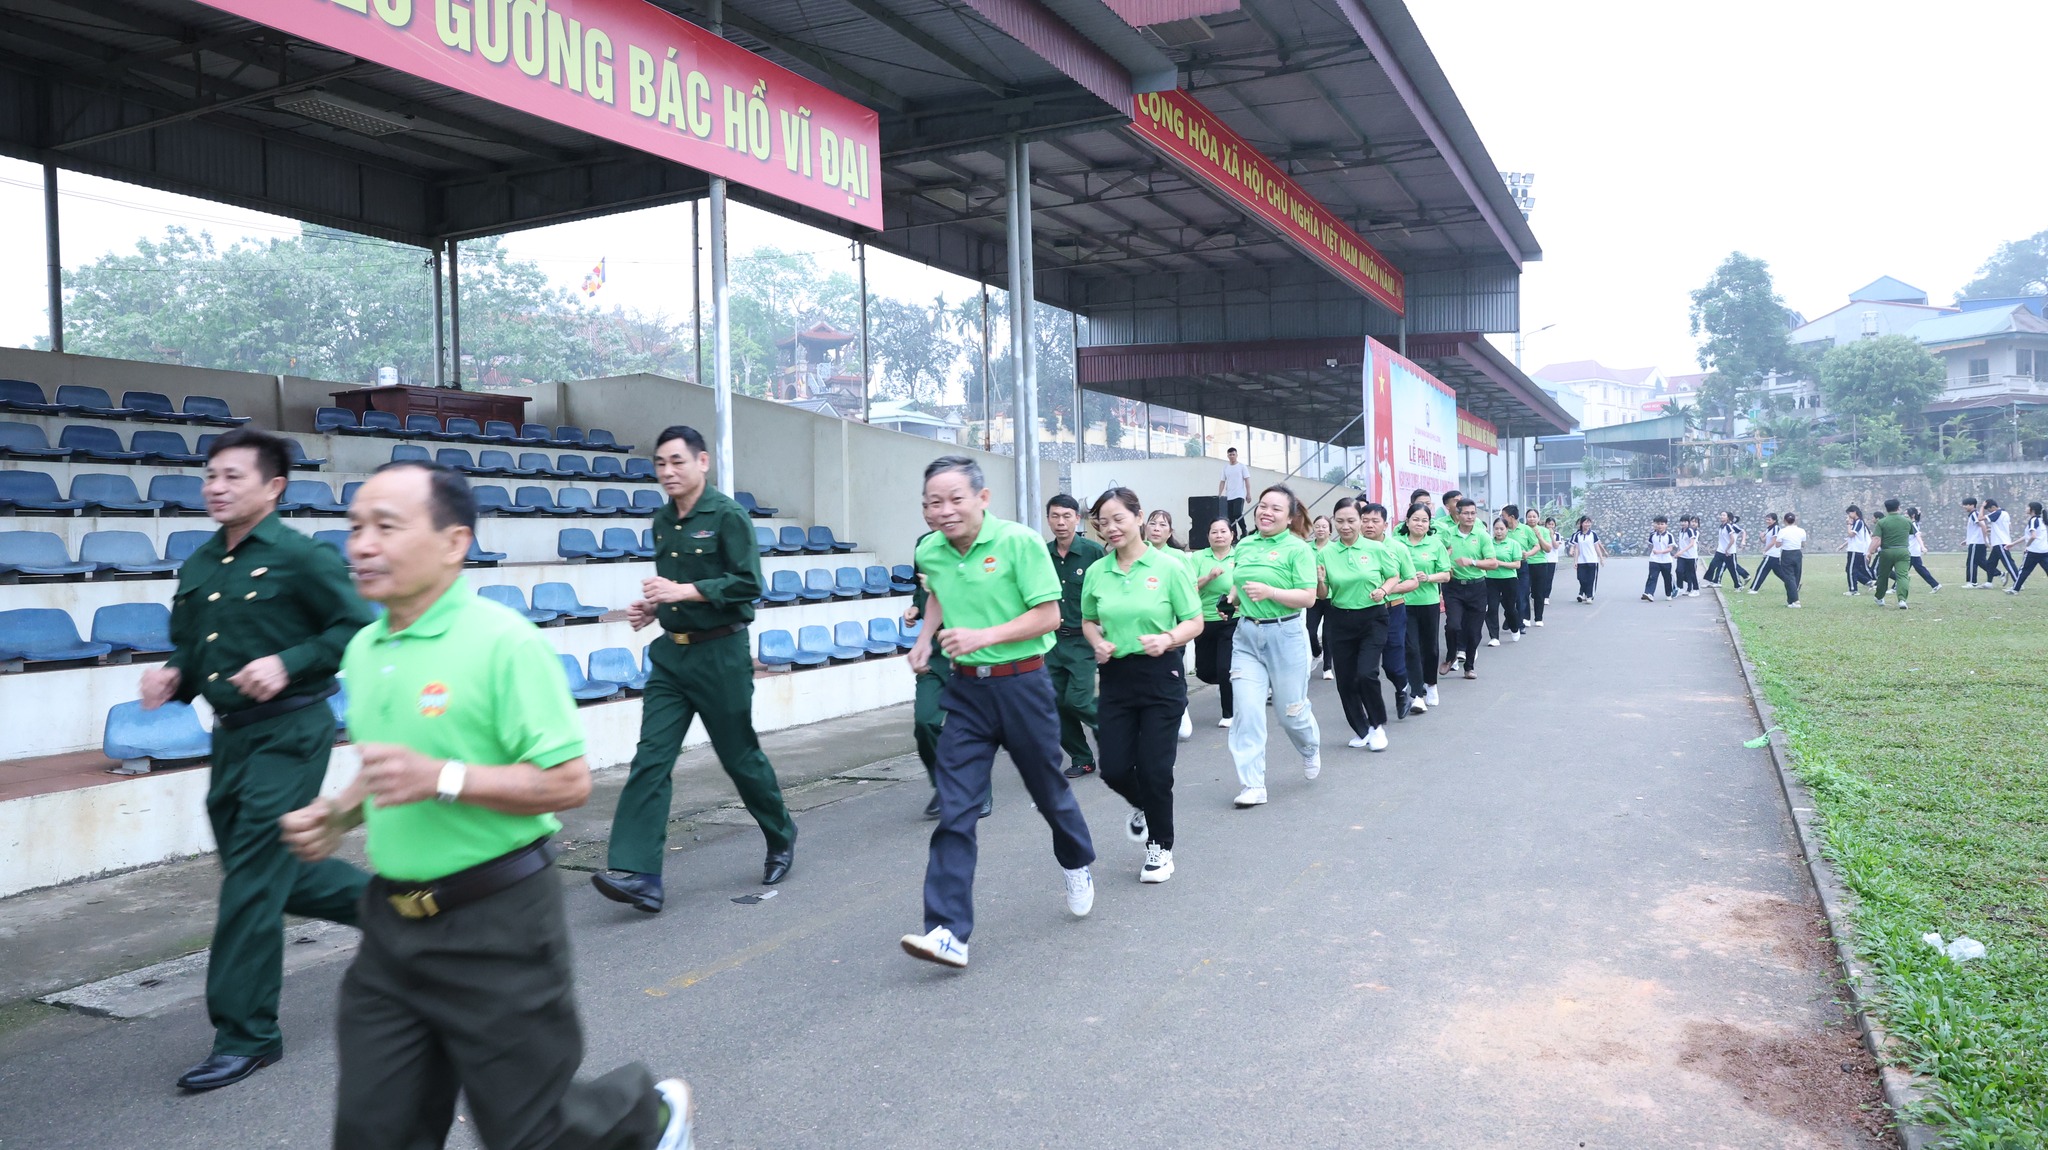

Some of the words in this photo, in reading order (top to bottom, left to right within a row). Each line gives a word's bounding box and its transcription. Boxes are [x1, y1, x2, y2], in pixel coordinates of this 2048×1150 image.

[628, 44, 711, 138] BÁC
[723, 78, 771, 161] HỒ
[780, 106, 812, 178] VĨ
[820, 126, 870, 207] ĐẠI
[1188, 118, 1220, 165] HÒA
[1222, 145, 1241, 182] XÃ
[1243, 160, 1264, 201] HỘI
[1266, 181, 1288, 216] CHỦ
[1290, 196, 1320, 241] NGHĨA
[1321, 222, 1339, 256] VIỆT
[1340, 236, 1358, 268] NAM
[1359, 255, 1379, 285] MUÔN
[1380, 267, 1395, 297] NĂM!
[1417, 446, 1432, 467] PHÁT
[1433, 450, 1447, 472] ĐỘNG
